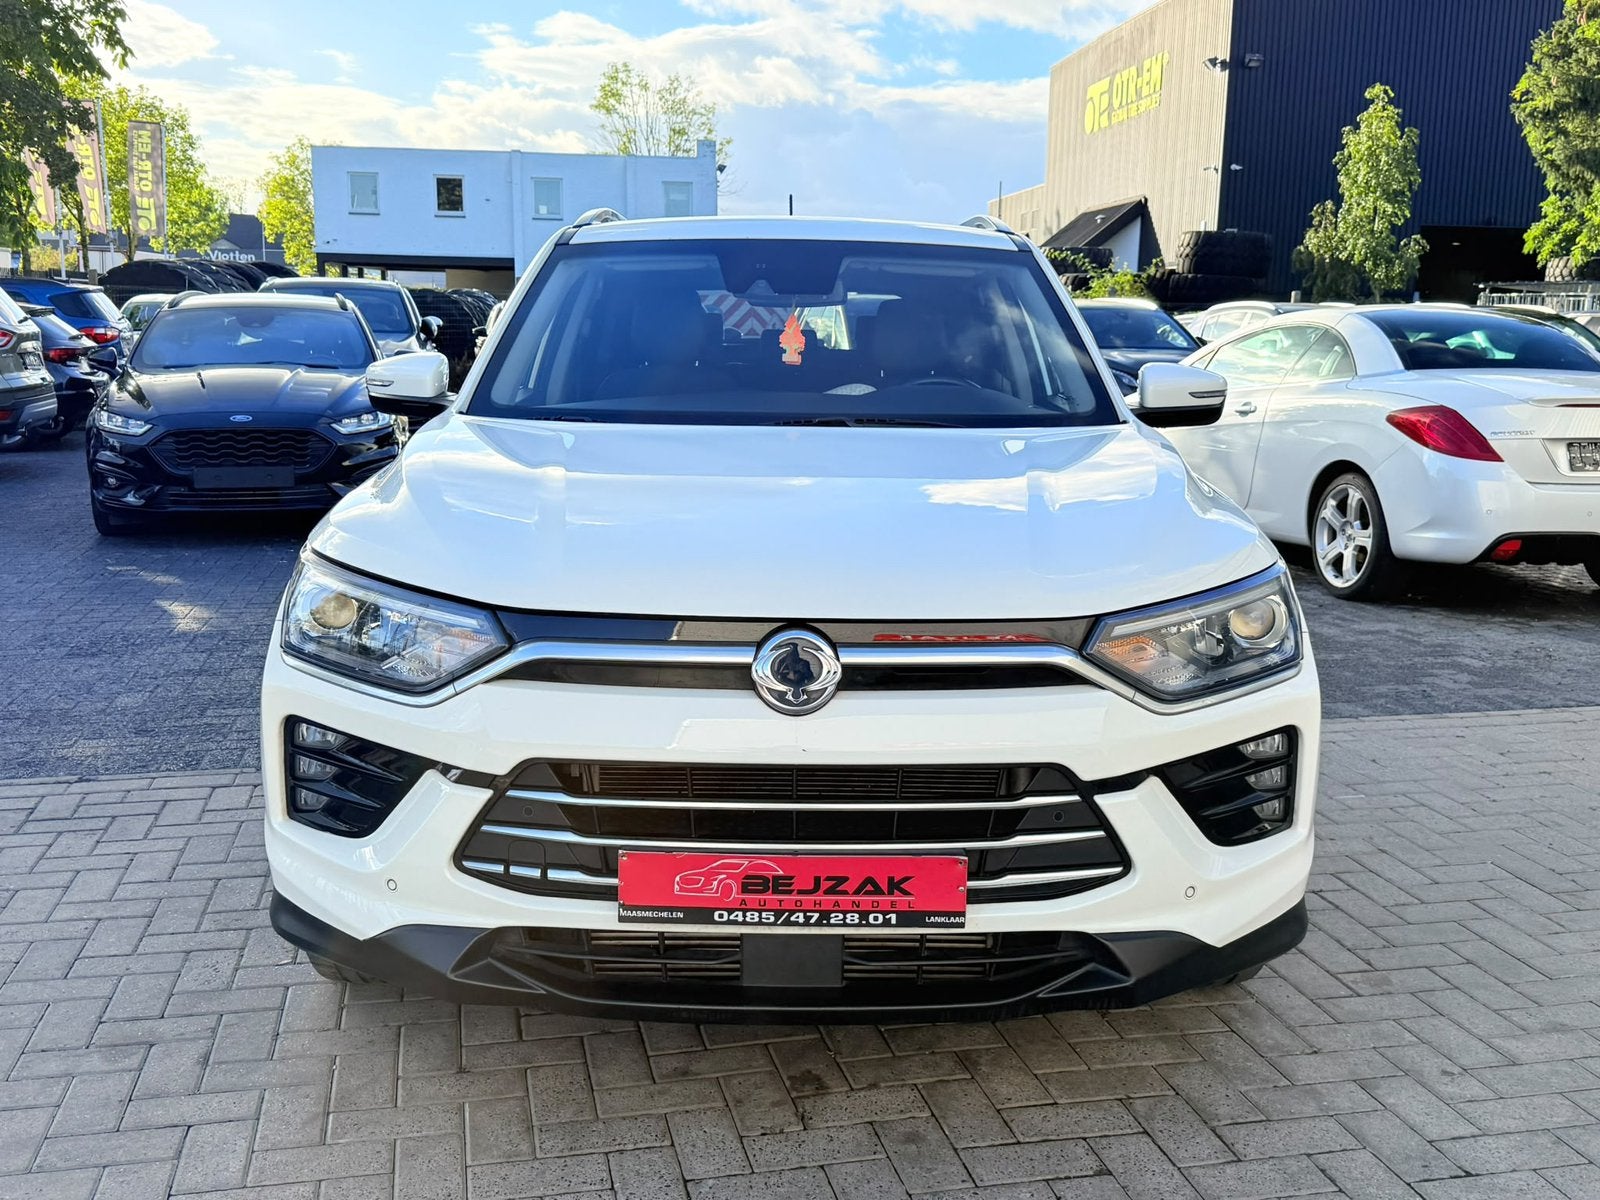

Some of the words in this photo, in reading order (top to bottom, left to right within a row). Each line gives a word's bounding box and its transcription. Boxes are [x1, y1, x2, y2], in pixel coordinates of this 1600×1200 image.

[208, 250, 256, 263] Vlotten
[741, 874, 915, 896] BEJZAK
[739, 899, 915, 909] AUTOHANDEL
[619, 908, 684, 919] MAASMECHELEN
[713, 910, 897, 925] 0485/47.28.01
[925, 916, 965, 924] LANKLAAR
